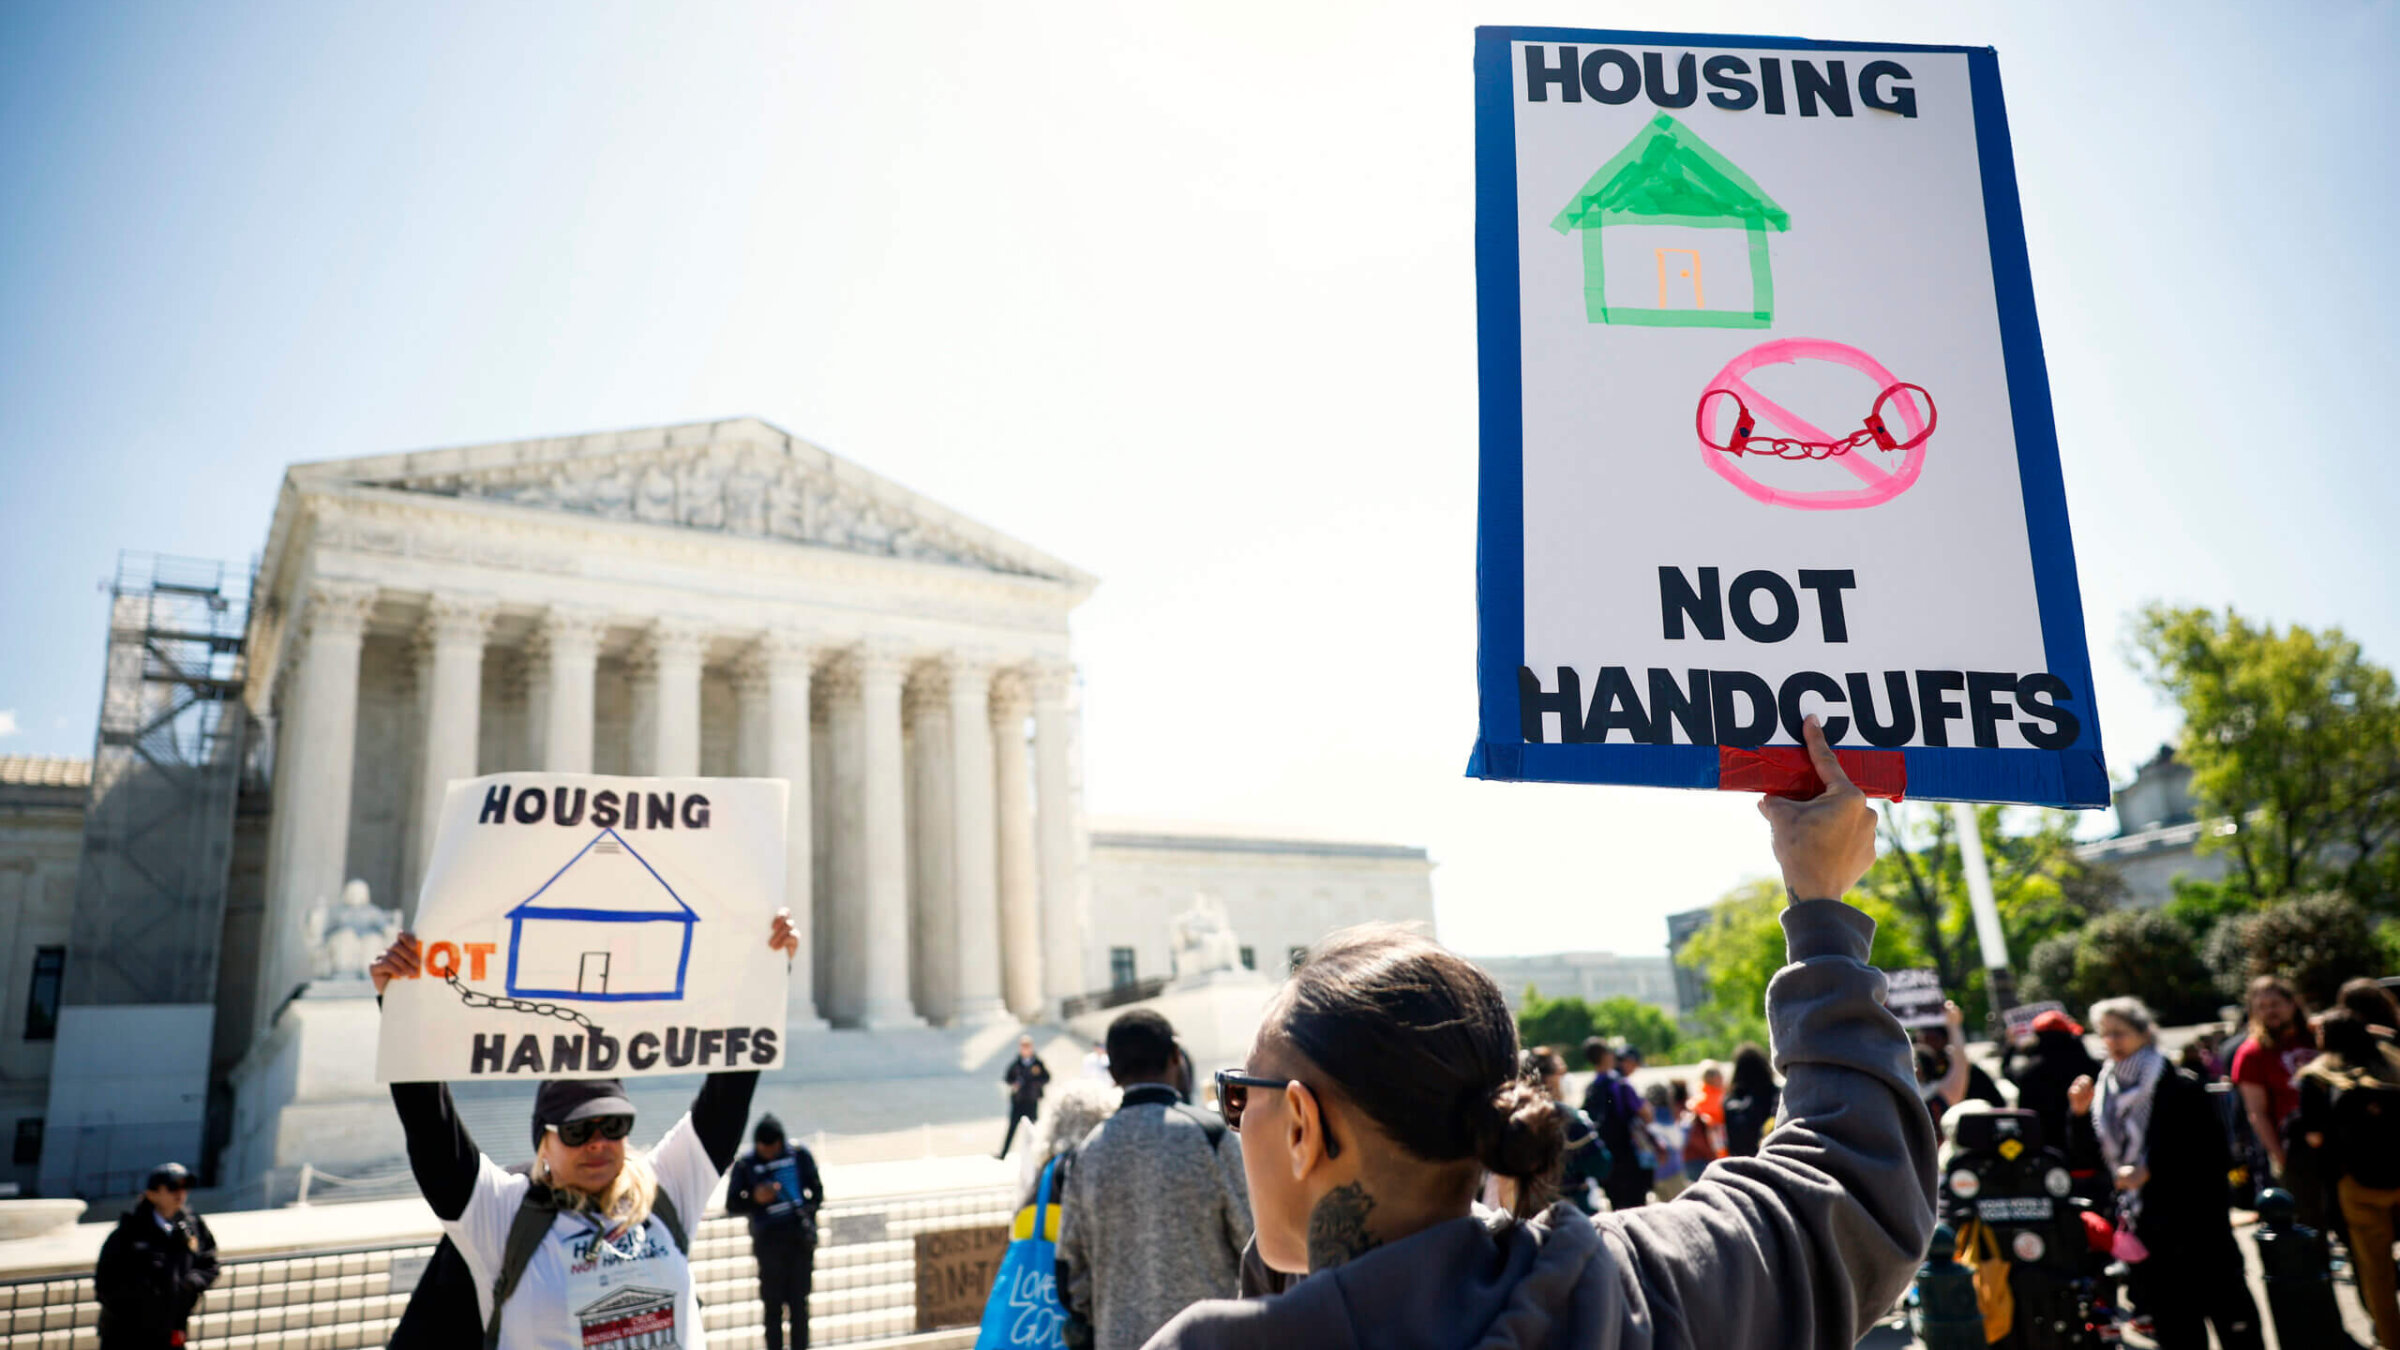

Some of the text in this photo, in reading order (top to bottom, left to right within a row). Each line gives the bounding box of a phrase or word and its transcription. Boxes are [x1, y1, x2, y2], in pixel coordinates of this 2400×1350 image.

[1524, 45, 1918, 118] HOUSING
[1658, 566, 1856, 643] NOT
[1518, 665, 2081, 750] HANDCUFFS
[479, 785, 710, 830] HOUSING
[389, 940, 496, 981] OT
[471, 1027, 778, 1074] HANDCUFFS
[1009, 1264, 1059, 1307] LOVE
